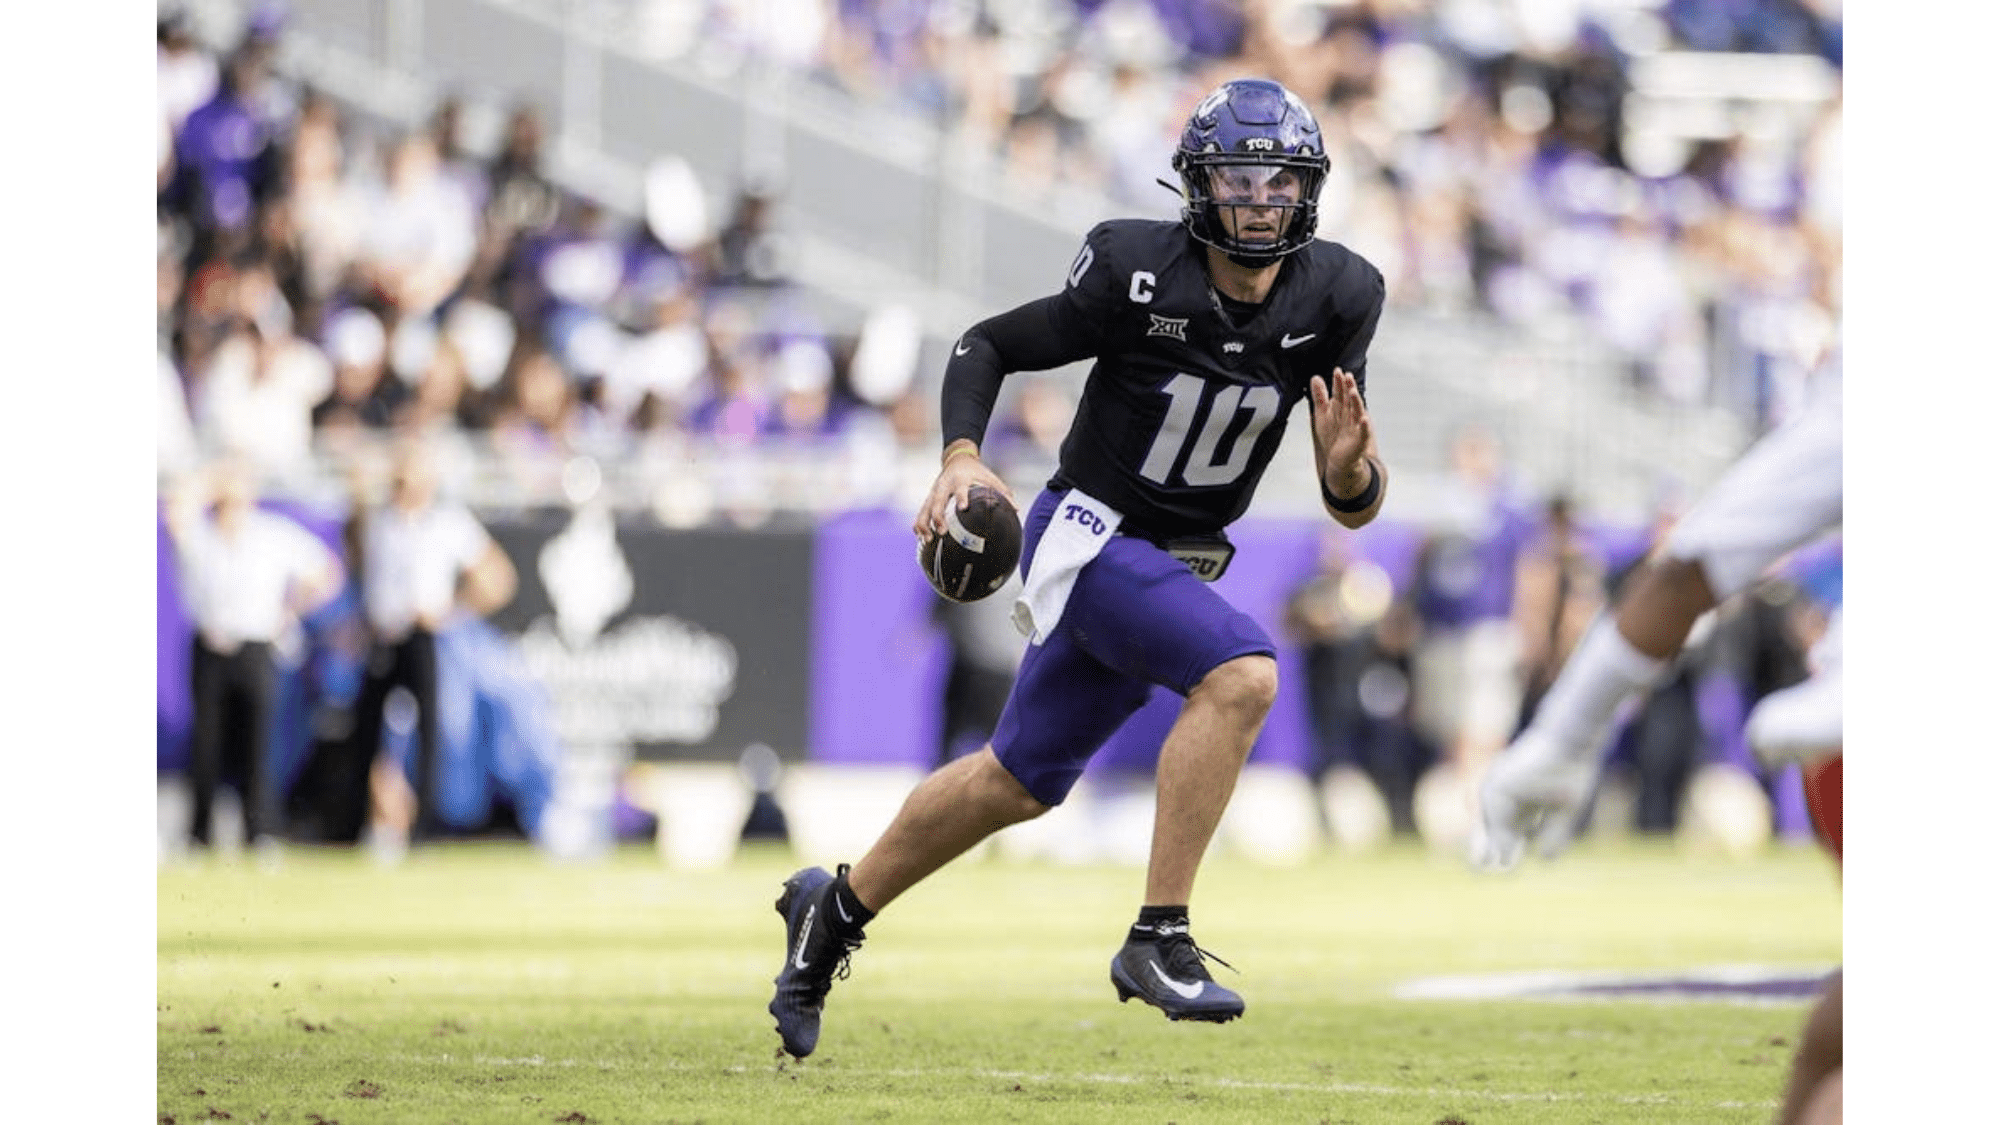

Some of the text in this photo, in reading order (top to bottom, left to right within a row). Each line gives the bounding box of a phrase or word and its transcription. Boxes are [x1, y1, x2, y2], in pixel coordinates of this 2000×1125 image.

[1246, 138, 1273, 151] TCU
[1129, 271, 1156, 303] C
[1222, 342, 1245, 353] TCU
[1139, 372, 1281, 487] 10
[1065, 504, 1106, 536] TCU
